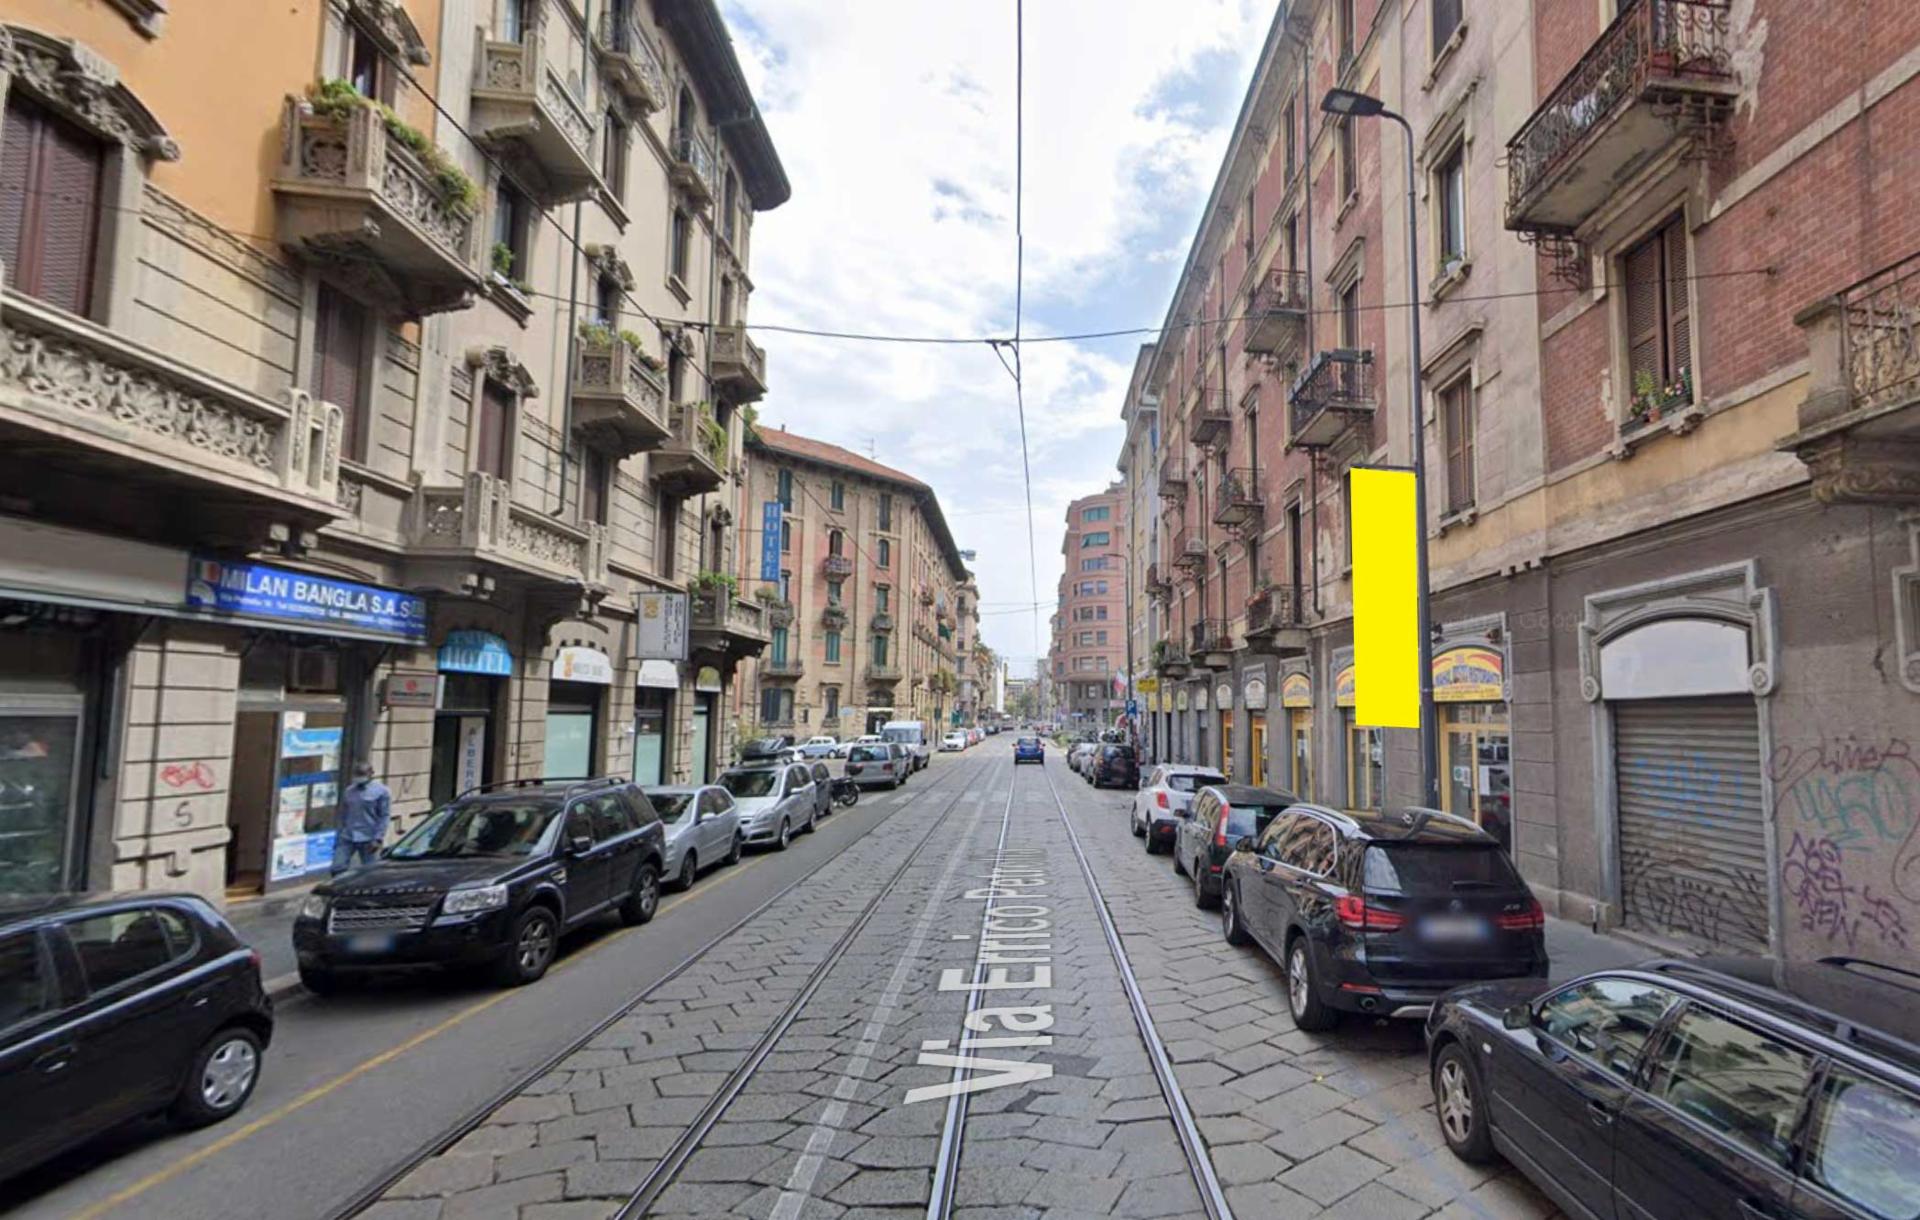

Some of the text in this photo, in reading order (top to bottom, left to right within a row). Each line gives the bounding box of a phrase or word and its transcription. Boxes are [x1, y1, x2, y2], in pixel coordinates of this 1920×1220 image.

[765, 505, 778, 578] HOTEL
[221, 567, 289, 598] MILAN
[294, 581, 367, 612] BANGLA
